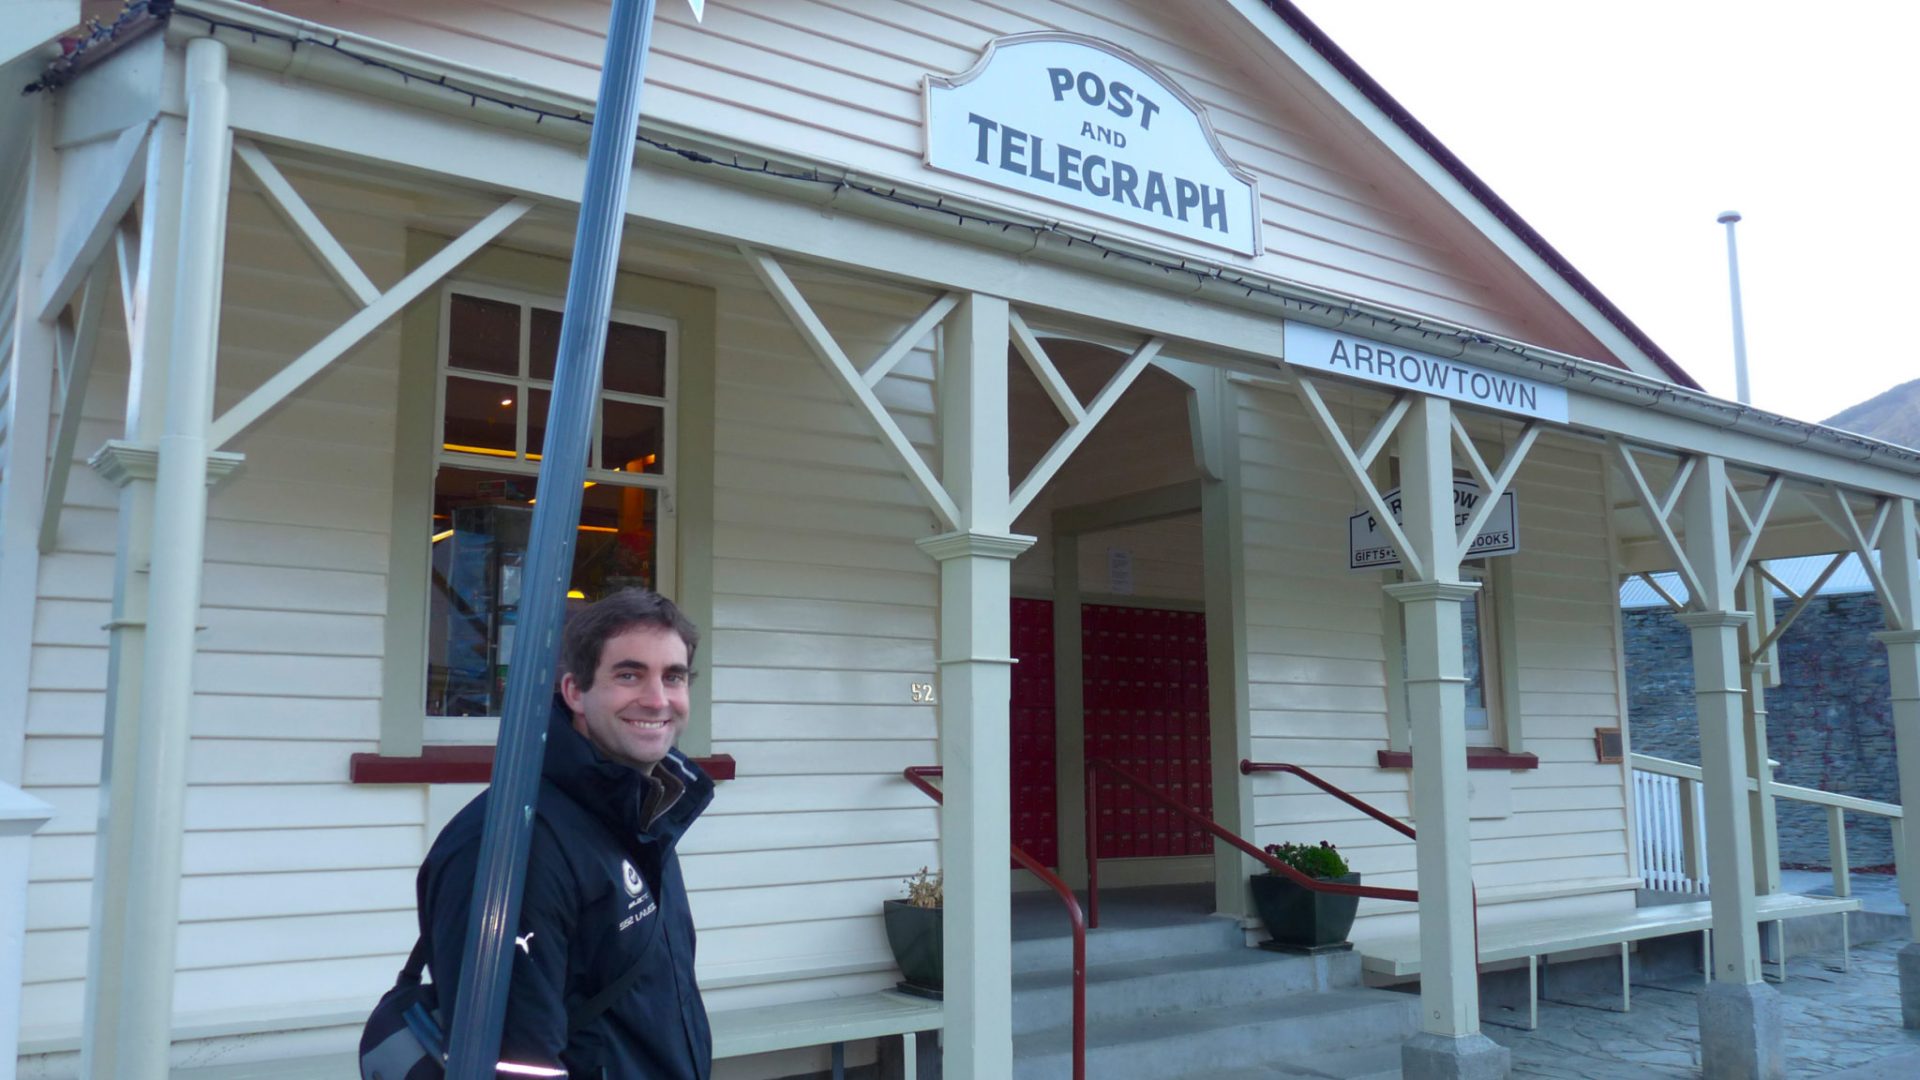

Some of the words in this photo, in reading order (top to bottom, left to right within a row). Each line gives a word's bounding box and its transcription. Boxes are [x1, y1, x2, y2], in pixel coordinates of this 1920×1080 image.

[1047, 67, 1160, 130] POST
[1080, 121, 1127, 149] AND
[968, 111, 1229, 234] TELEGRAPH
[1329, 339, 1537, 411] ARROWTOWN
[1355, 550, 1386, 562] GIFTS
[911, 683, 935, 702] 52
